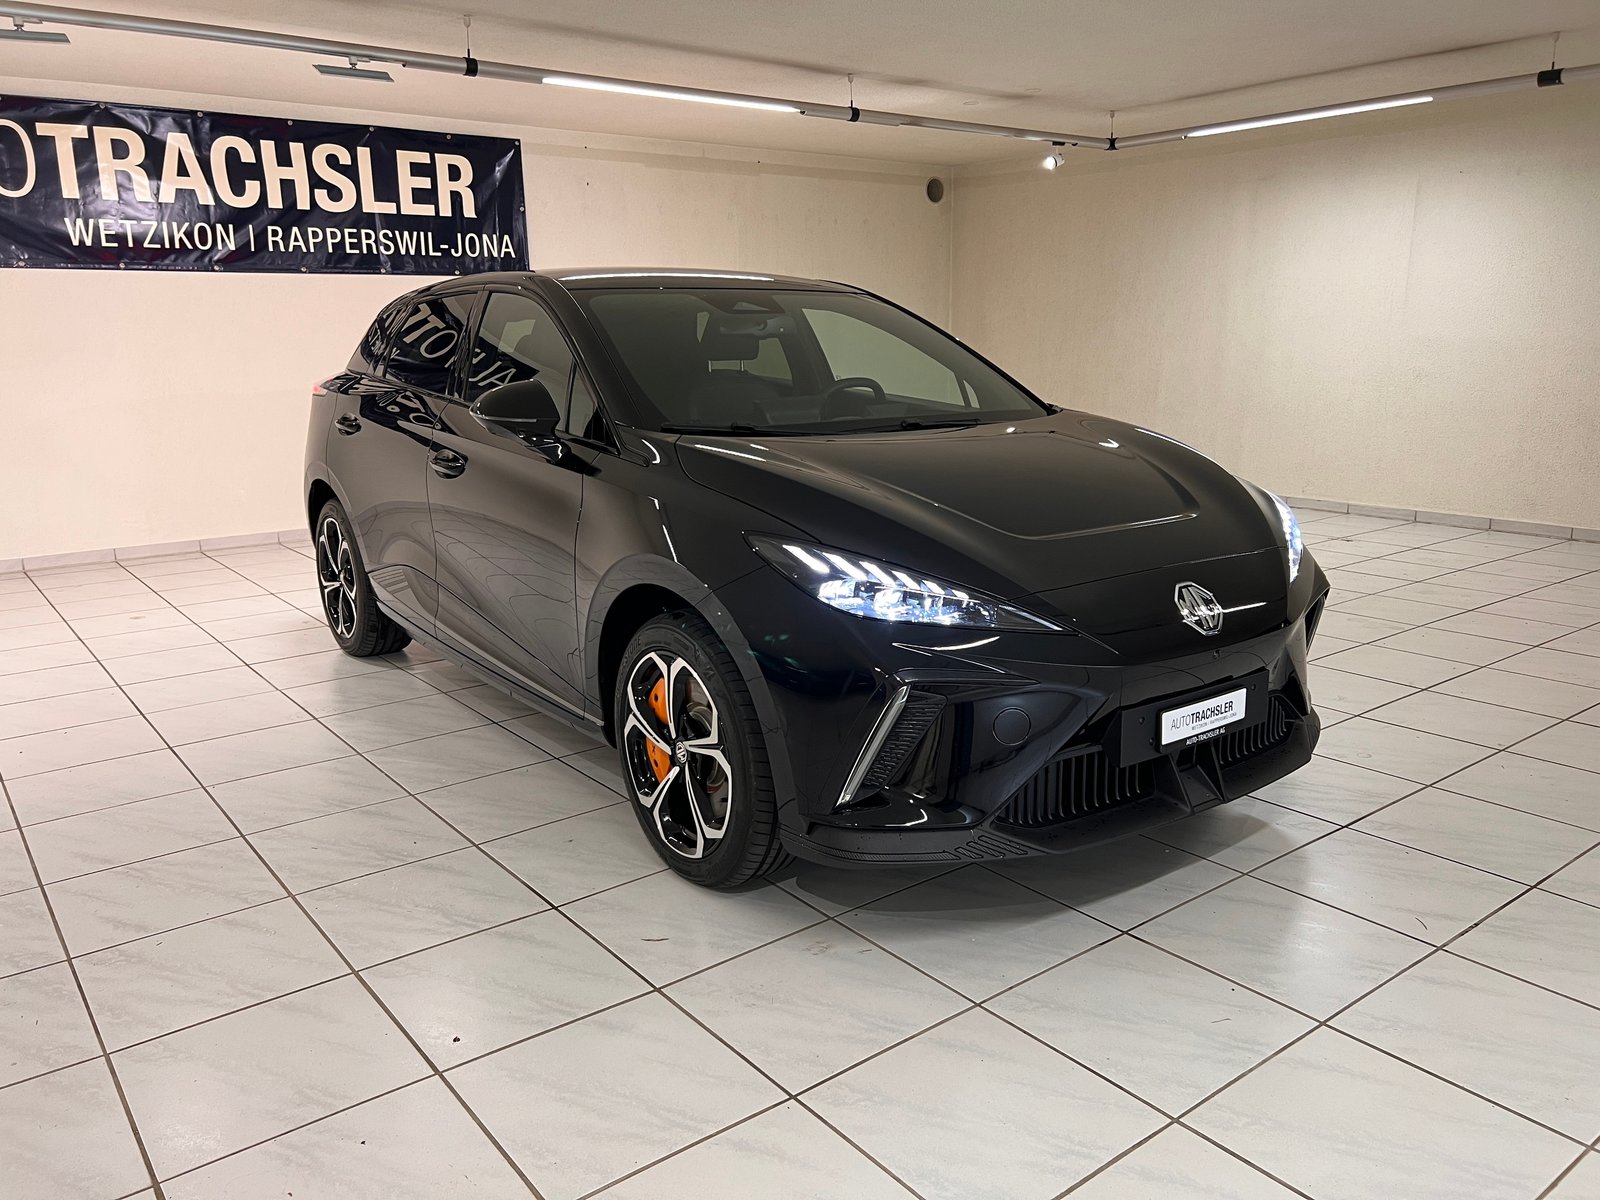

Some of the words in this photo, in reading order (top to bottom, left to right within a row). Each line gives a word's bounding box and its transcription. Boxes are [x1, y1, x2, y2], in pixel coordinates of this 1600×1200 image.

[66, 217, 236, 251] WETZIKON
[267, 227, 515, 258] RAPPERSWIL-JONA
[1171, 701, 1234, 731] AUTOTRACHSLER
